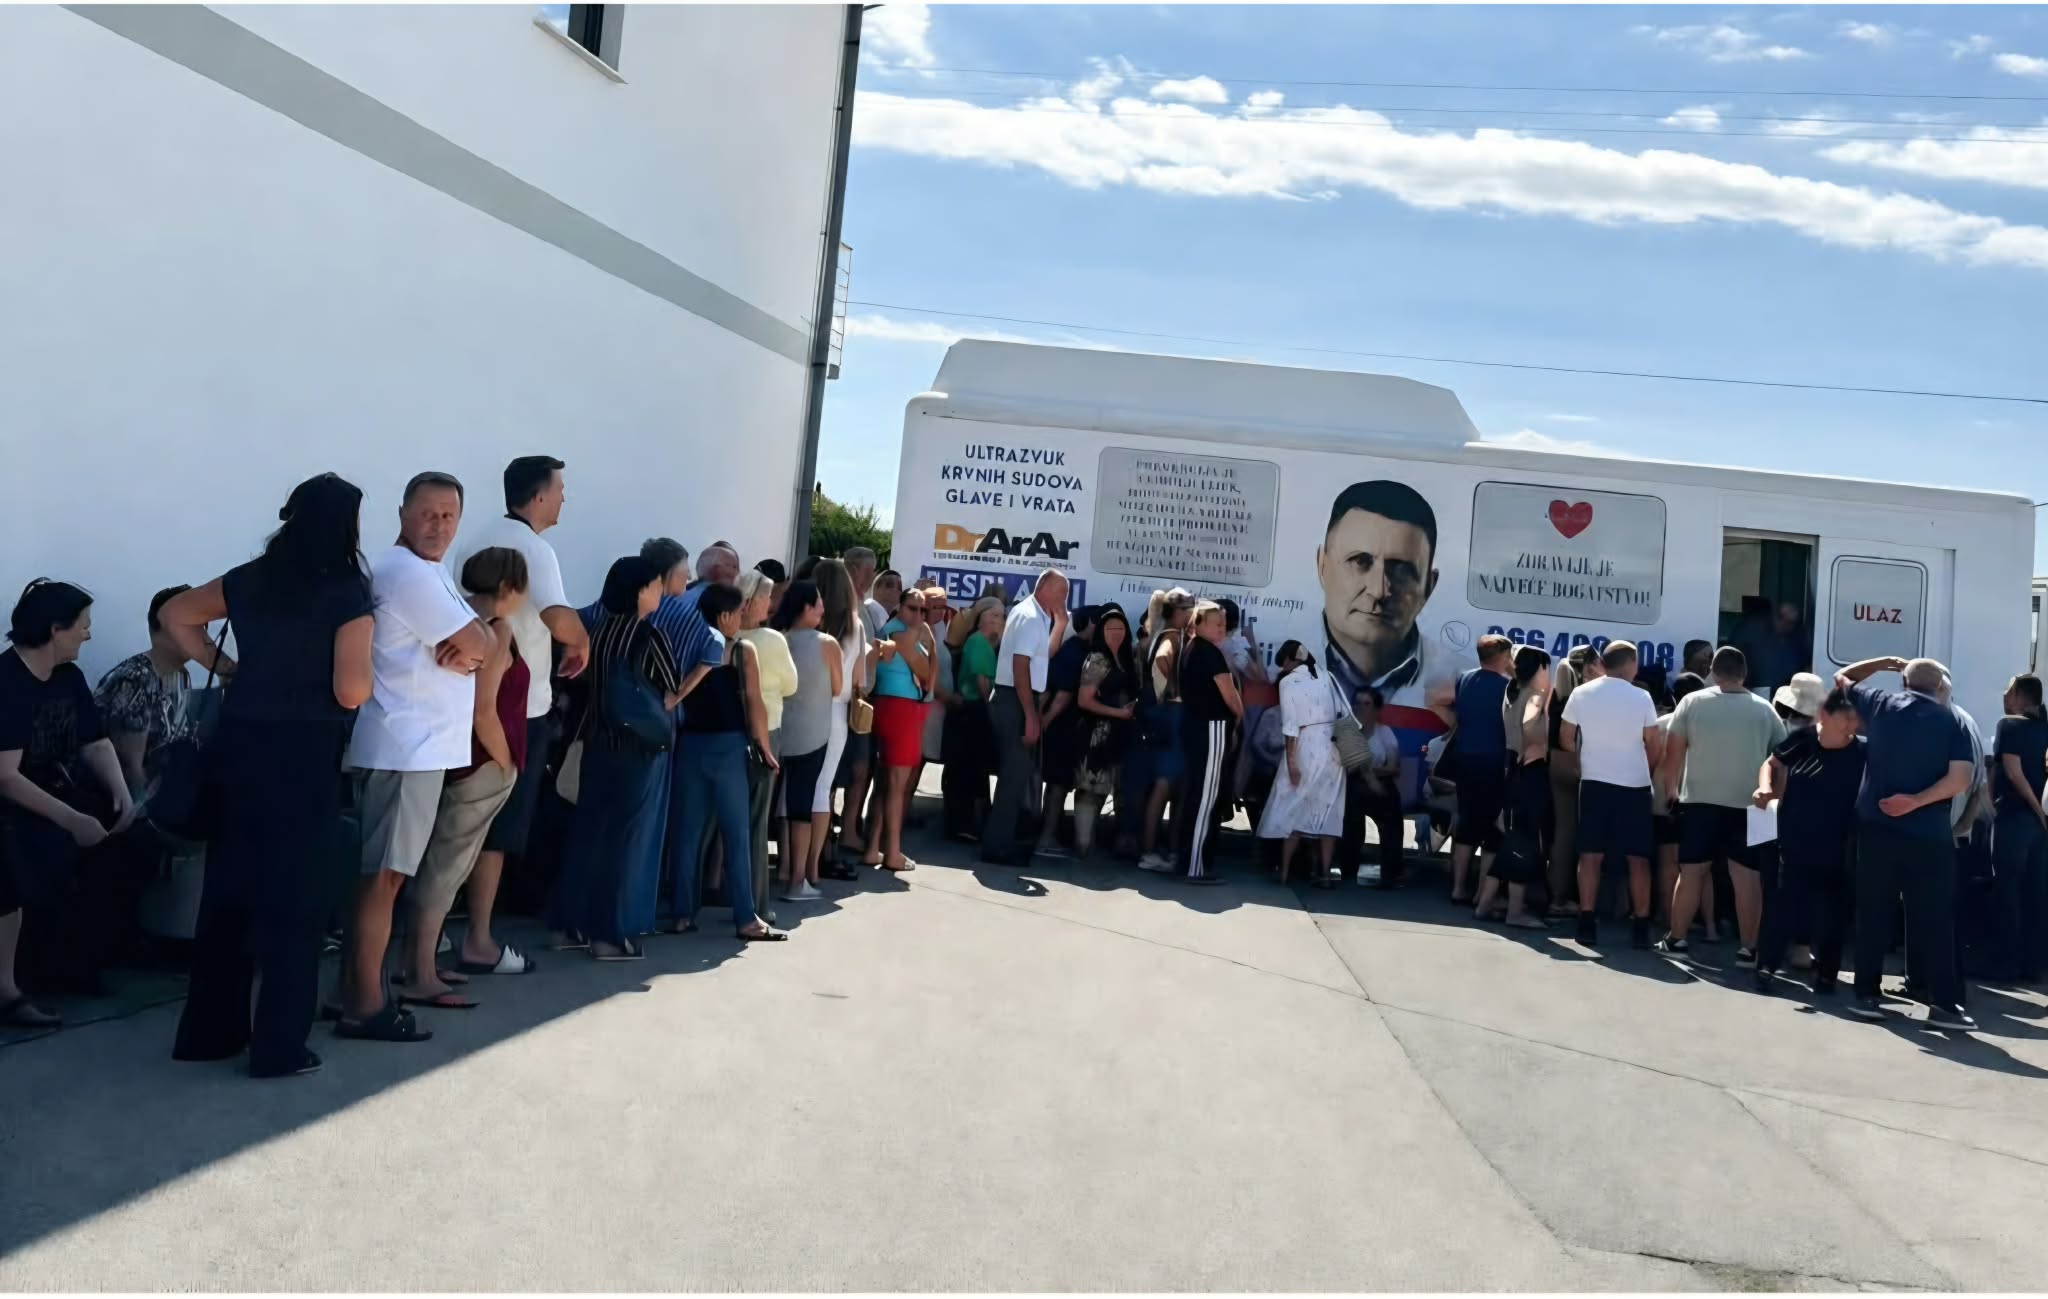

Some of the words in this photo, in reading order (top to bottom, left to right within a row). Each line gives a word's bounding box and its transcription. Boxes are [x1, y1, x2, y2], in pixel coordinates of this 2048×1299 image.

[965, 444, 1065, 466] ULTRAZVUK
[941, 465, 1006, 485] KRVNIH
[1011, 471, 1083, 491] SUDOVA
[945, 488, 1003, 507] GLAVE
[1009, 494, 1014, 508] I
[1021, 494, 1076, 514] VRATA
[1853, 602, 1903, 624] ULAZ
